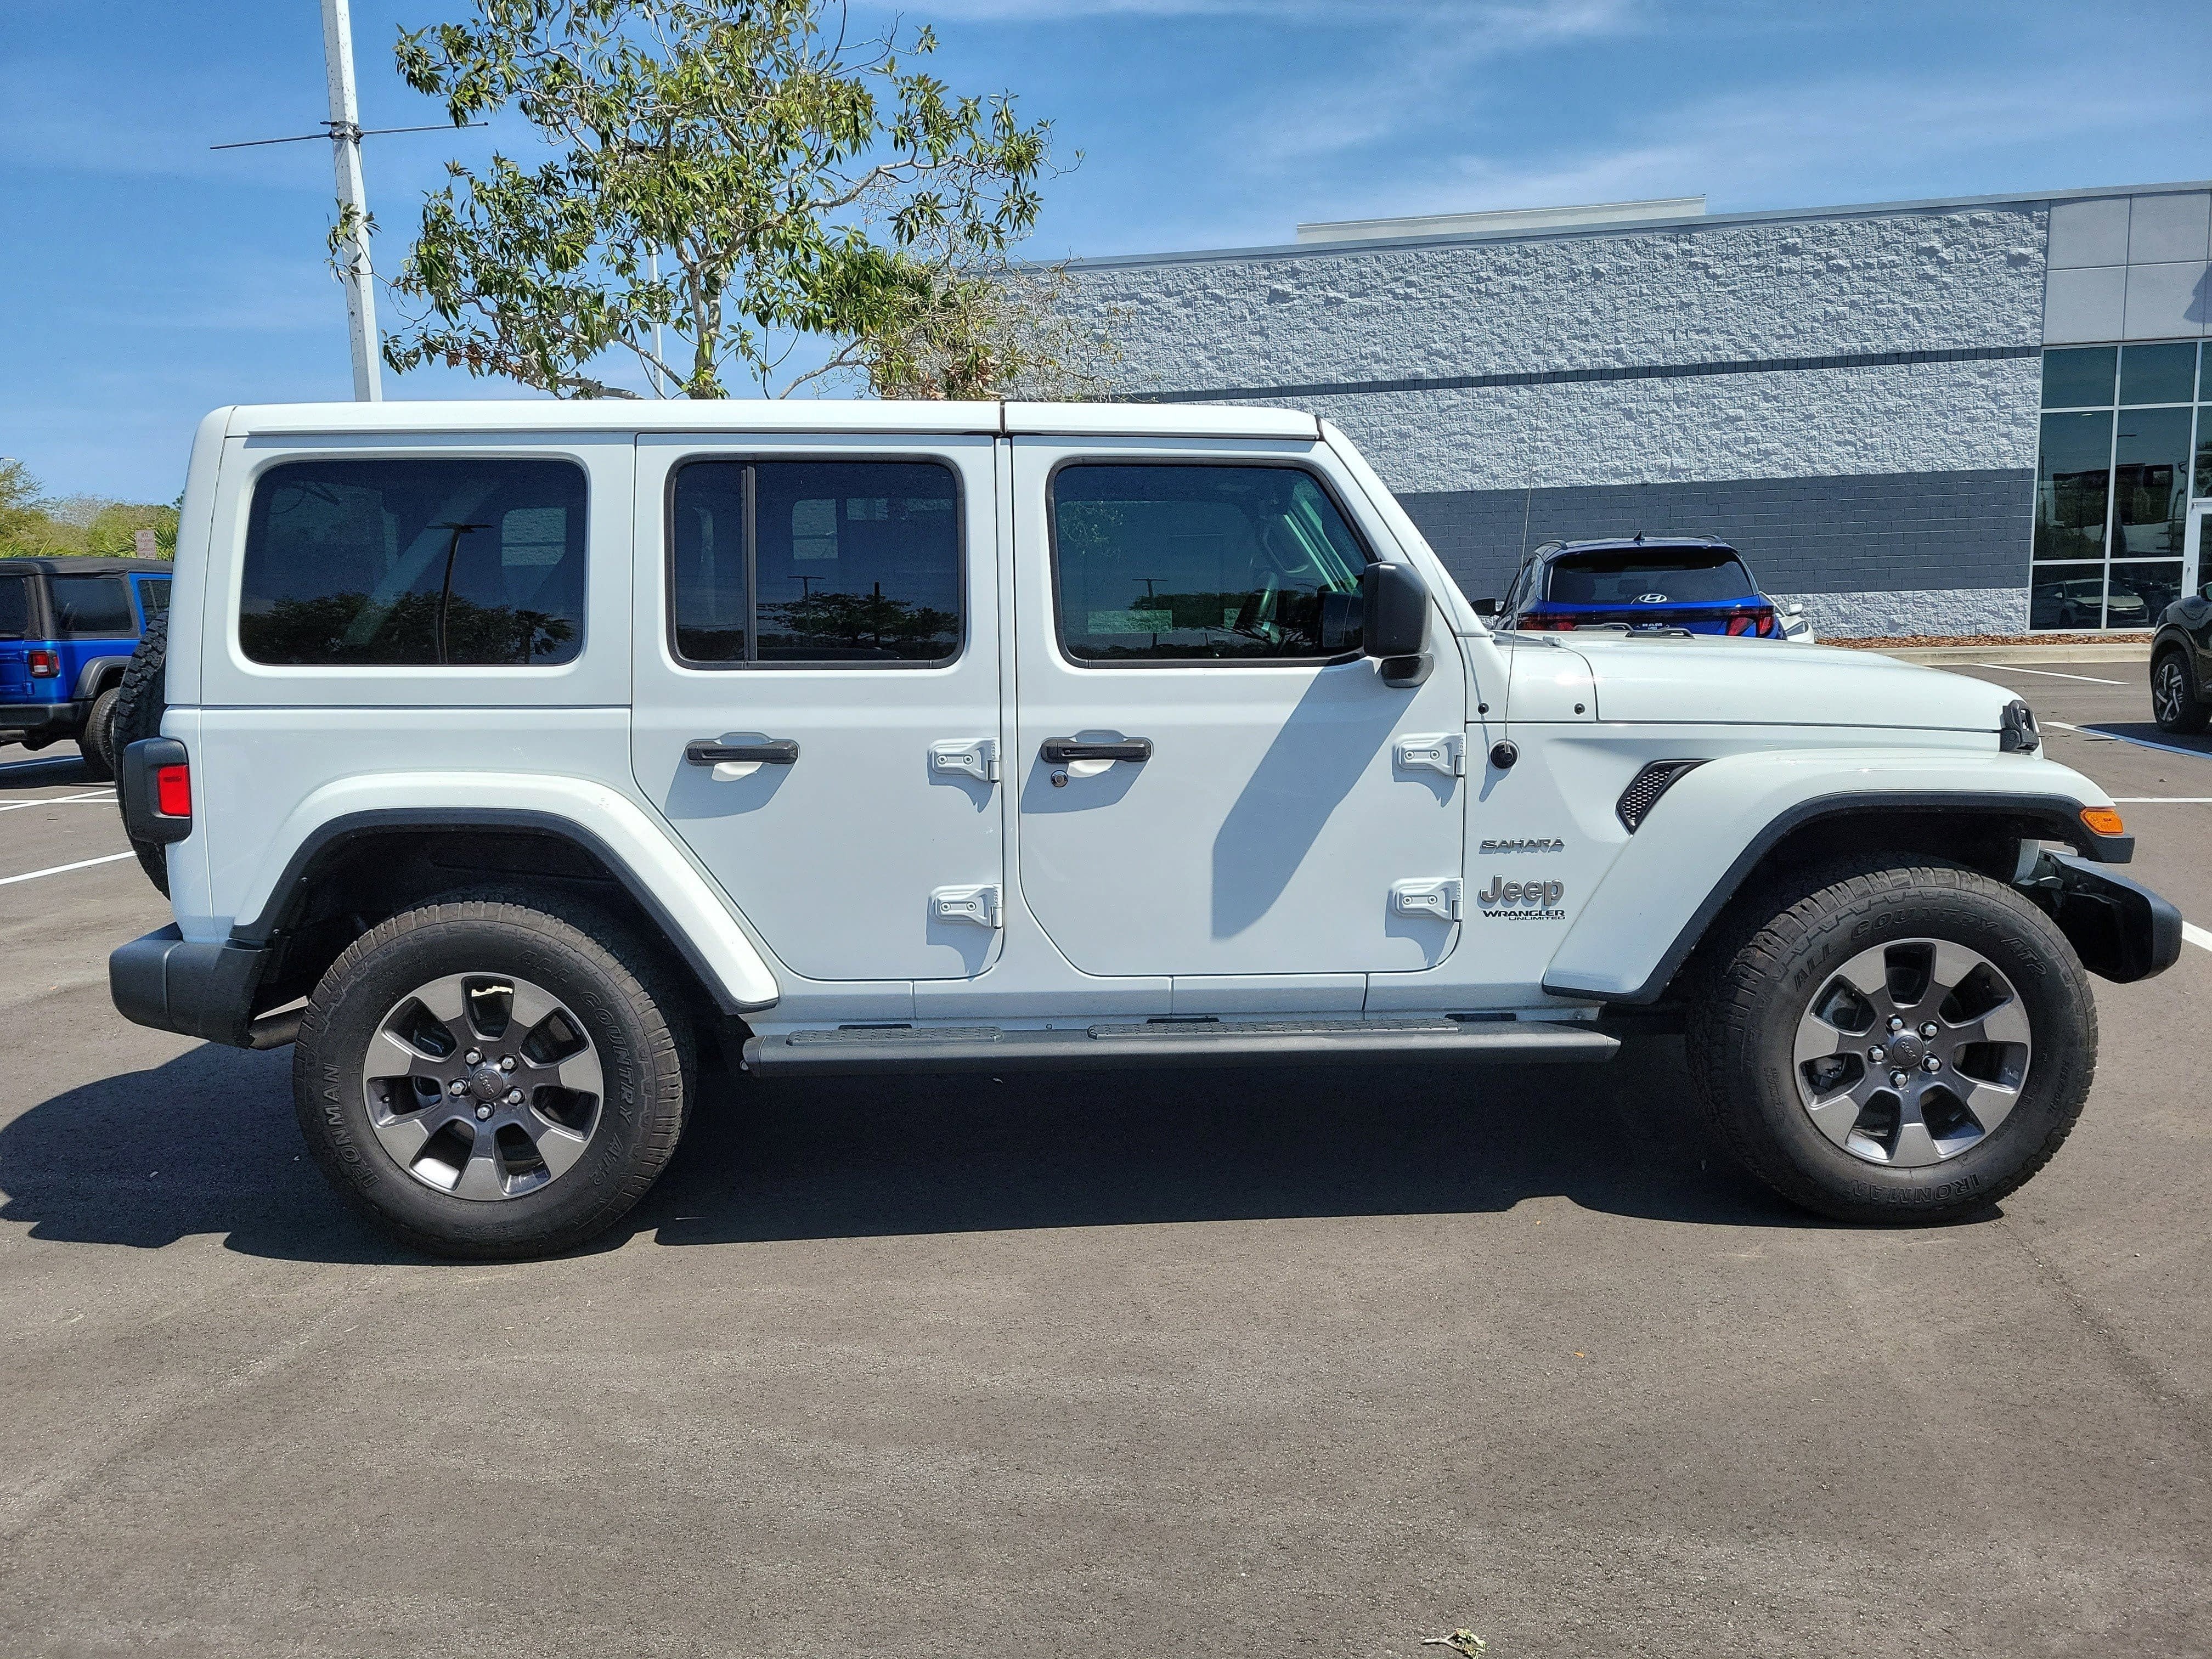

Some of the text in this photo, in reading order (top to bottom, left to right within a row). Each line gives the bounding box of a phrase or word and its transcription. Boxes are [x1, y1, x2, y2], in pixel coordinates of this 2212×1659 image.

[1481, 838, 1565, 849] SAHARA
[1480, 874, 1564, 906] Jeep
[1795, 942, 1837, 992] ALL
[579, 991, 636, 1127] COUNTRY
[323, 1063, 380, 1188] IRONMAN
